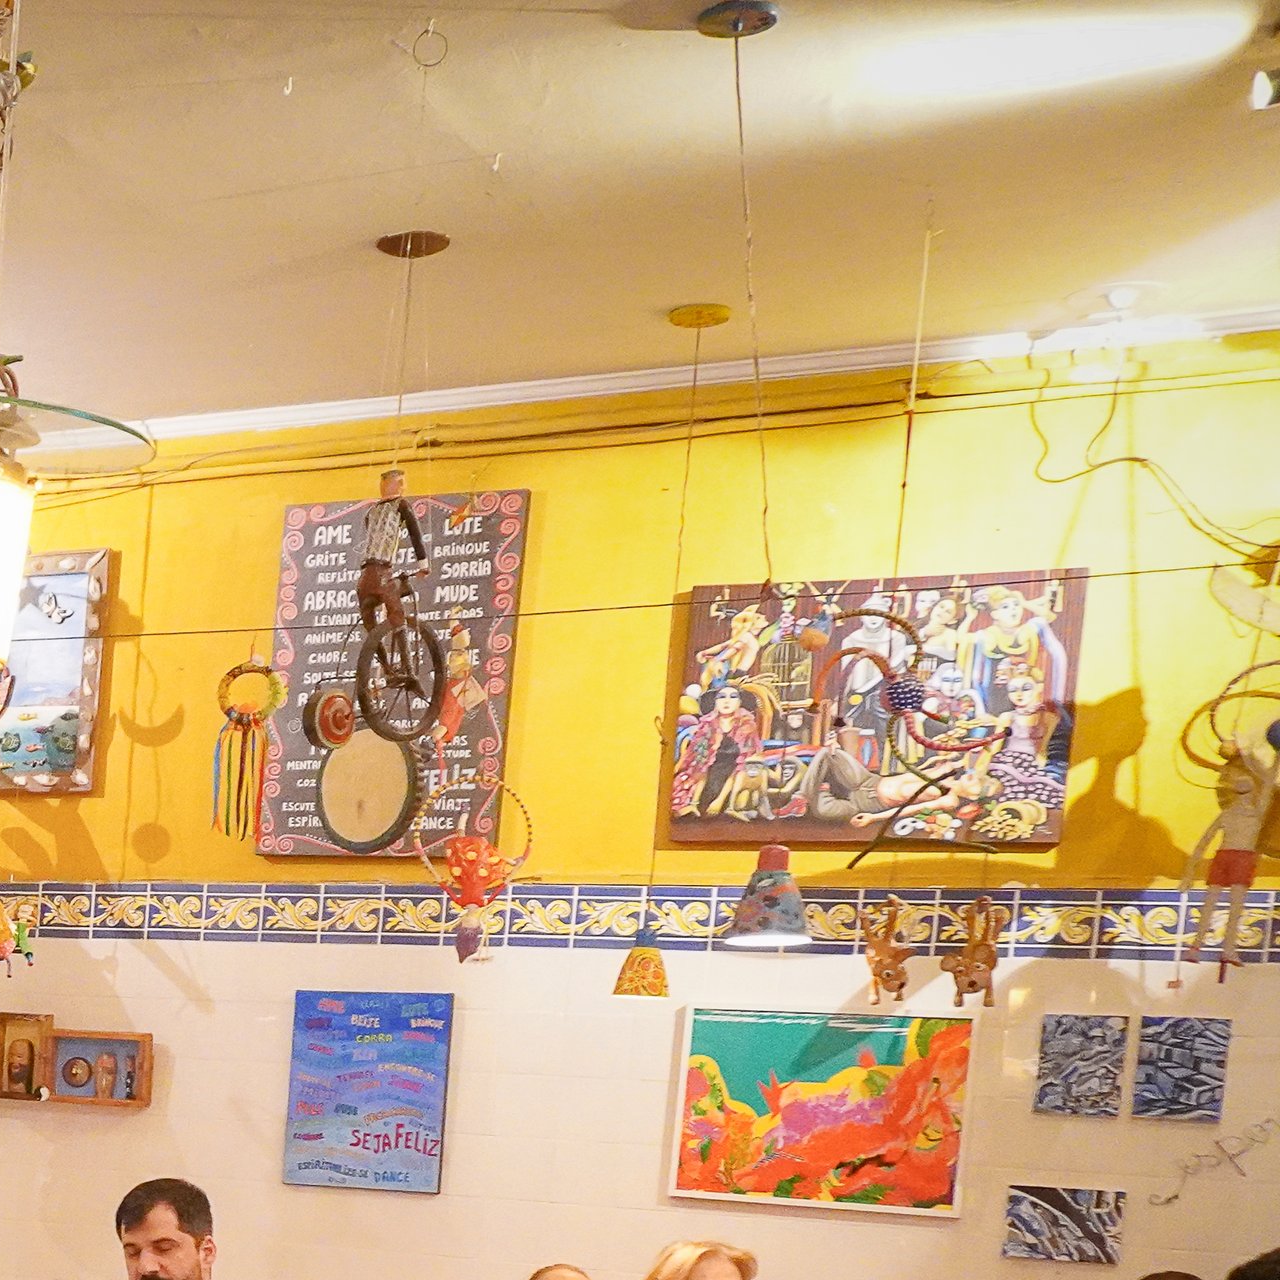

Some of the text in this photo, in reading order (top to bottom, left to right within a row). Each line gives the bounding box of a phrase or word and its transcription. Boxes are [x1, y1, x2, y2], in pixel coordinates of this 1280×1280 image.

[313, 524, 352, 547] AME
[434, 584, 479, 604] MUDE
[309, 650, 348, 664] CHORE
[281, 802, 317, 811] ESCUTE
[355, 1032, 393, 1044] CORRA
[349, 1129, 393, 1155] SEJA
